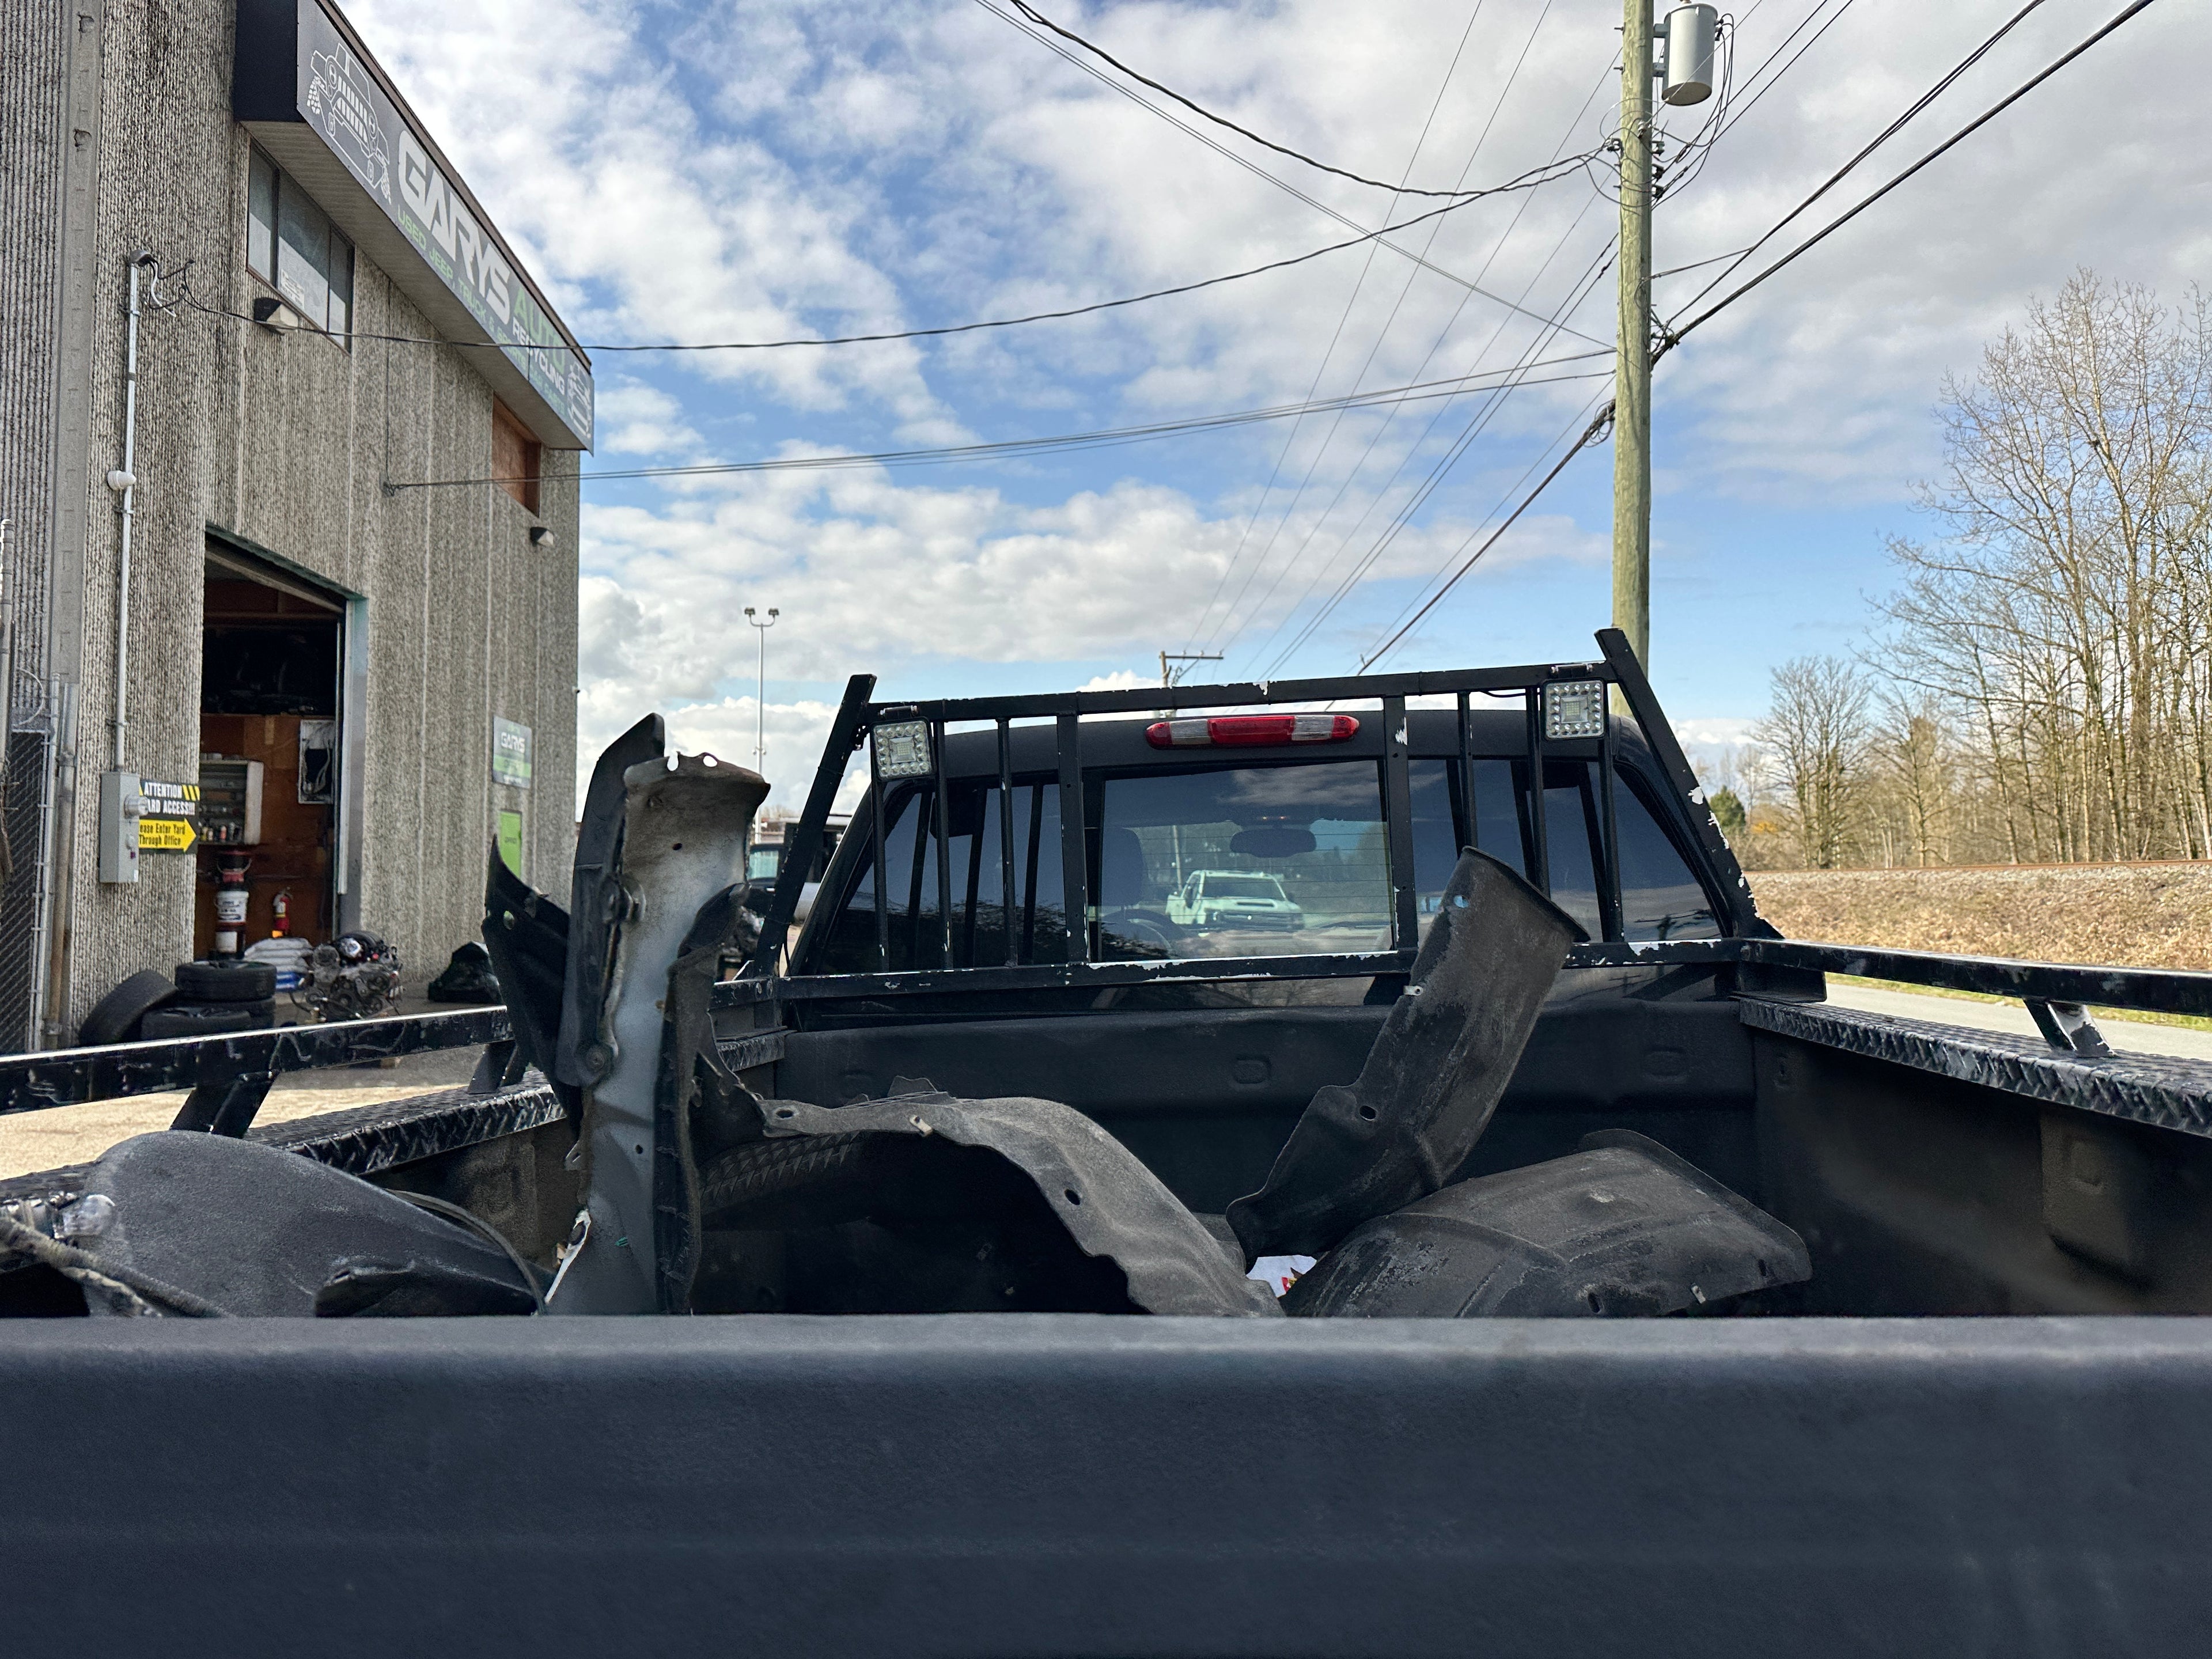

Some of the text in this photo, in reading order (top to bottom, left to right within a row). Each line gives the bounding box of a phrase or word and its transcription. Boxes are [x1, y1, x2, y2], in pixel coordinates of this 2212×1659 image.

[397, 204, 426, 251] USED
[458, 276, 487, 324] TRUCK
[398, 130, 565, 374] GARYS AUTO
[512, 316, 565, 396] RECYCLING
[143, 781, 183, 799] ATTENTION
[139, 835, 181, 847] Through Office
[156, 823, 172, 834] Enter
[173, 824, 185, 835] Yard
